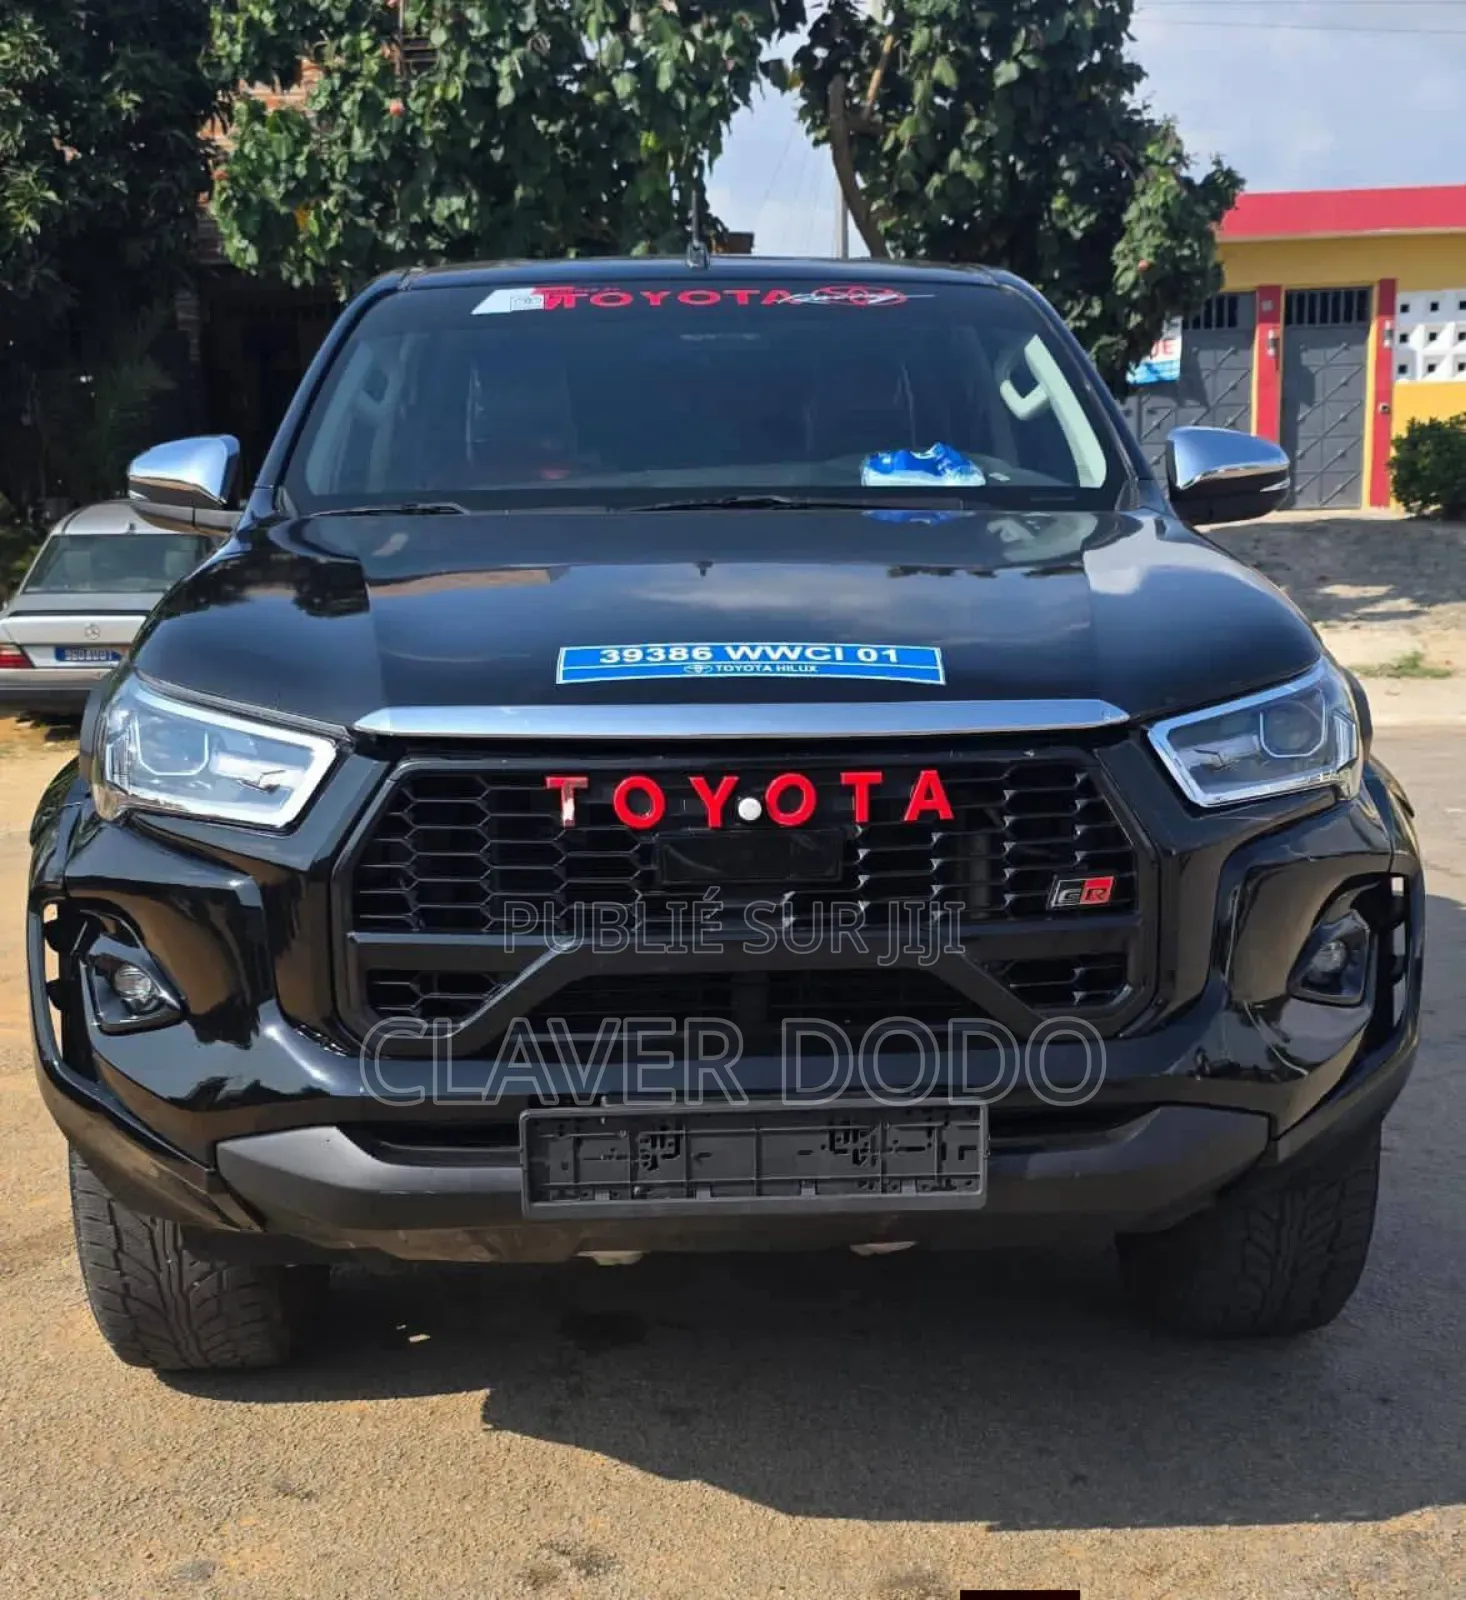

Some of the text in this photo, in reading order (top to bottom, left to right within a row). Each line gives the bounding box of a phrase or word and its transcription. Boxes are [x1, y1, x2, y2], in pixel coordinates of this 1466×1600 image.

[552, 289, 801, 309] TOYOTA
[599, 645, 899, 664] 39386 WWCI 01
[715, 664, 819, 673] TOYOTA HILUX
[545, 769, 955, 829] TOYOTA
